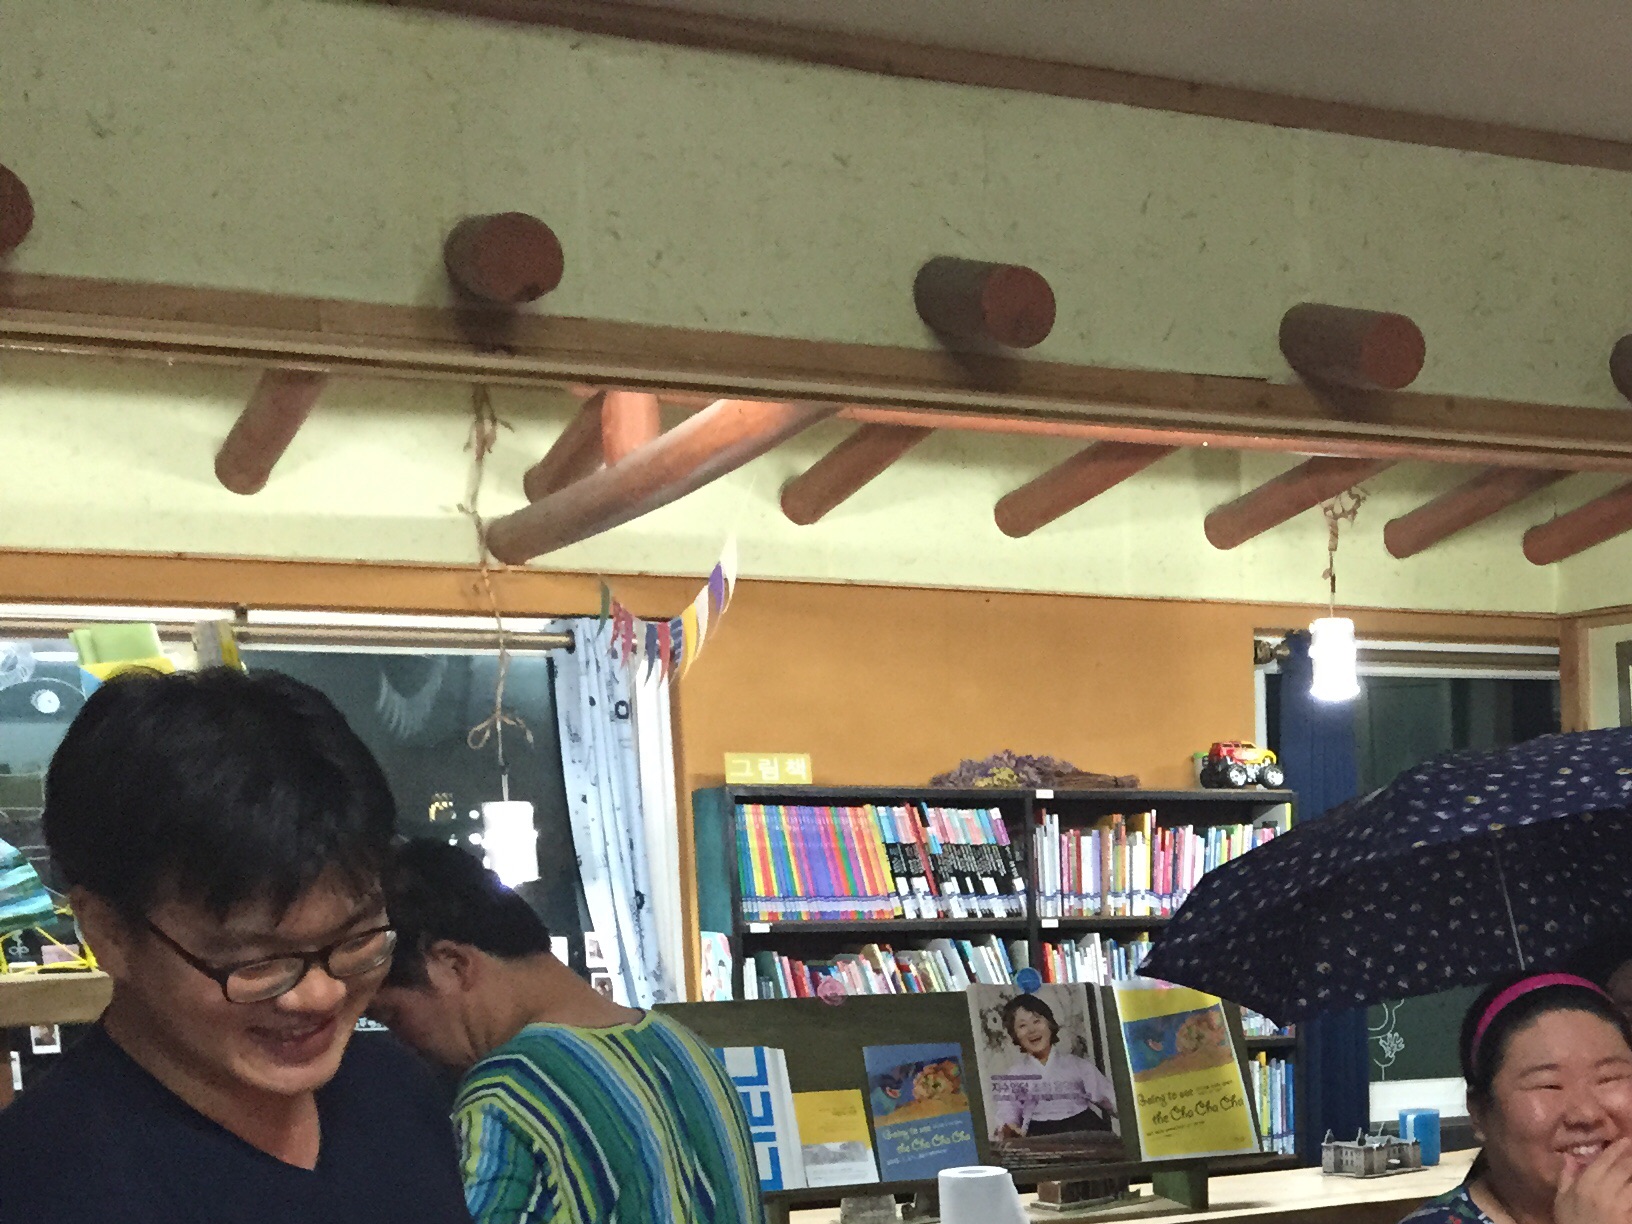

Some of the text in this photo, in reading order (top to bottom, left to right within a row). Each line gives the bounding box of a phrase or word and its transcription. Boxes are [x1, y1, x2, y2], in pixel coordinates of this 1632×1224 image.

[1137, 1092, 1166, 1107] Going
[1152, 1093, 1244, 1126] the Cha Cha Cha
